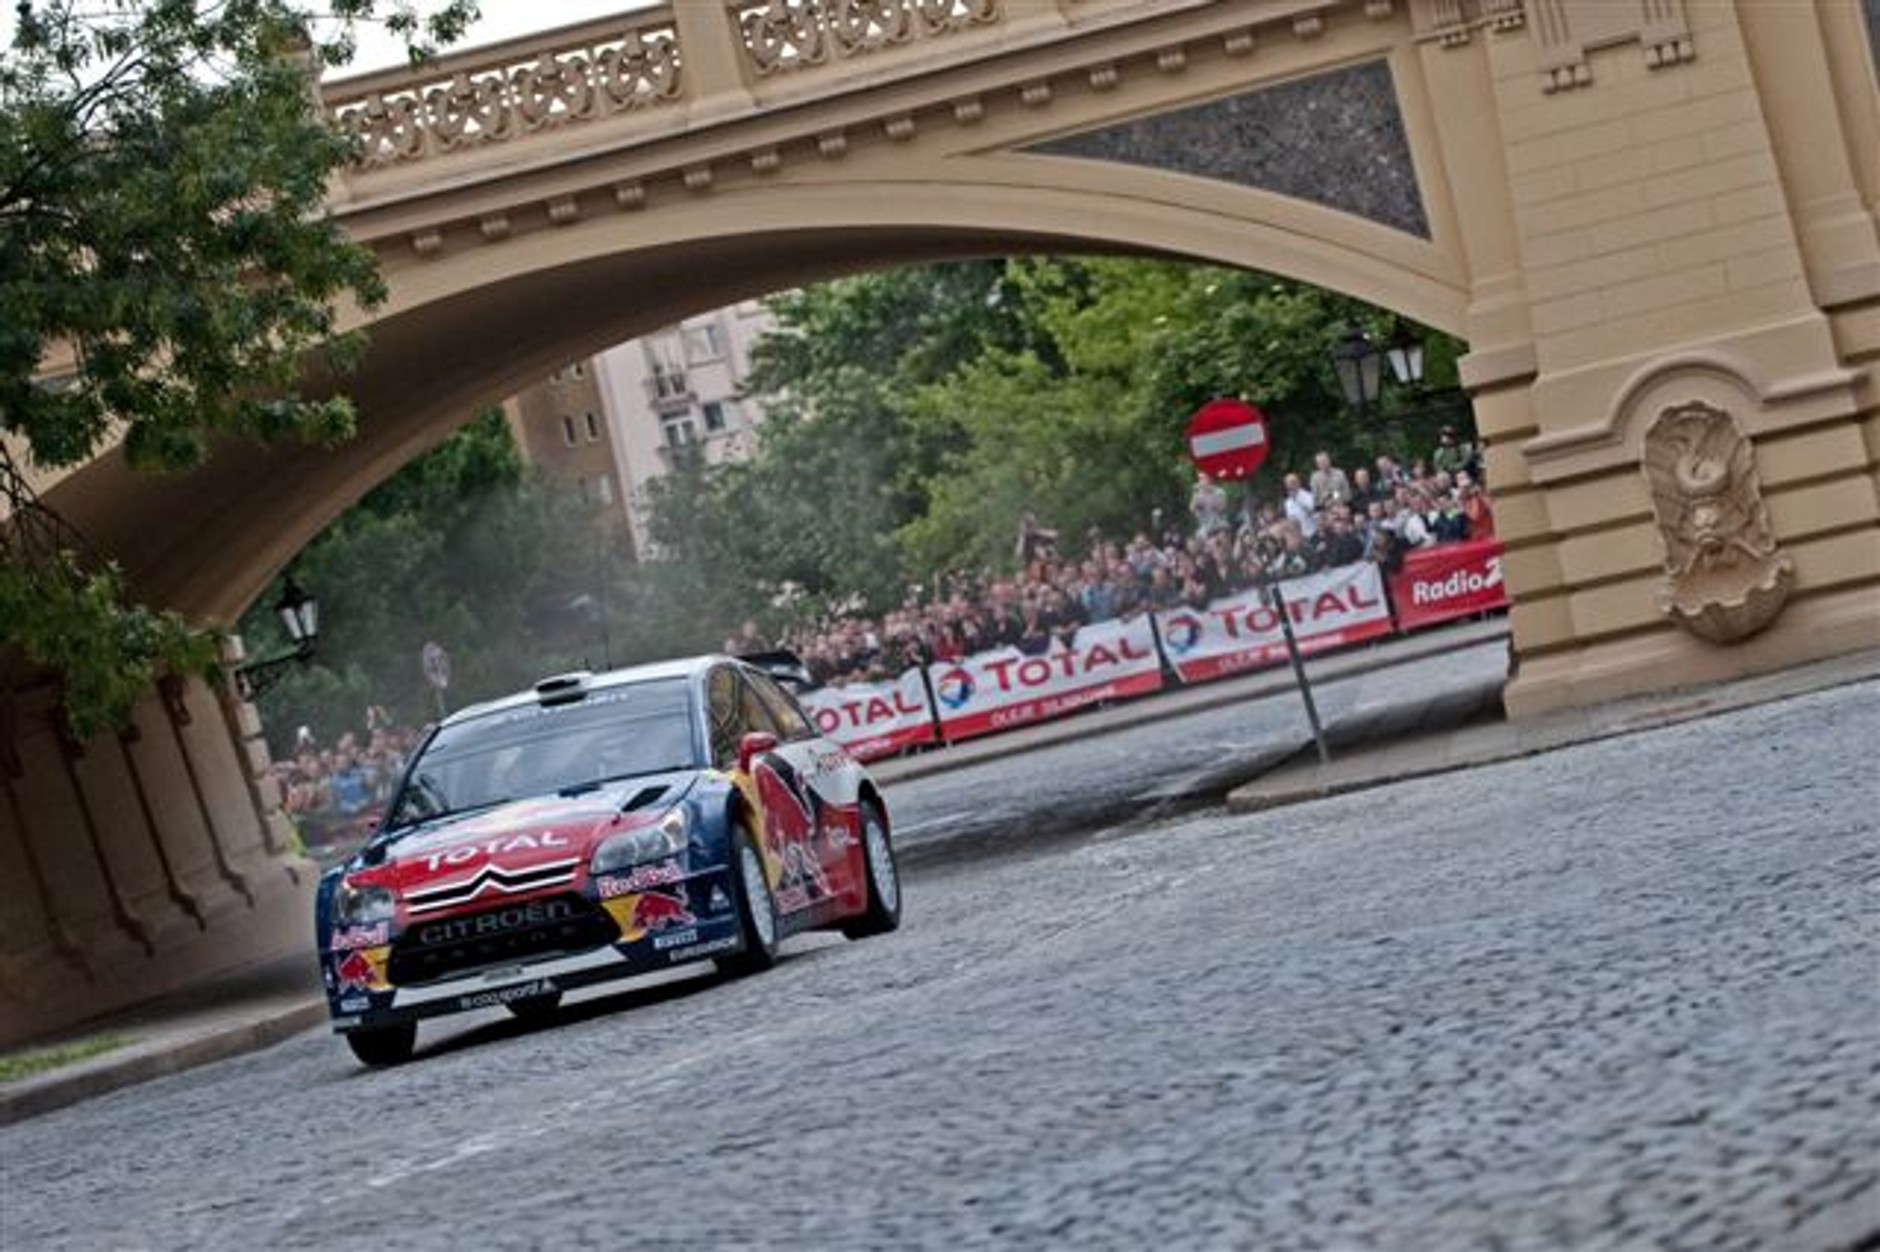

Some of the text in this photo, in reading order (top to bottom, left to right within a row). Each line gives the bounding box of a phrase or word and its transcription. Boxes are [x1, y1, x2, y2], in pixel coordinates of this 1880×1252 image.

[1210, 585, 1378, 639] TOTAL
[983, 637, 1152, 692] TOTAL
[423, 831, 569, 872] TOTAL
